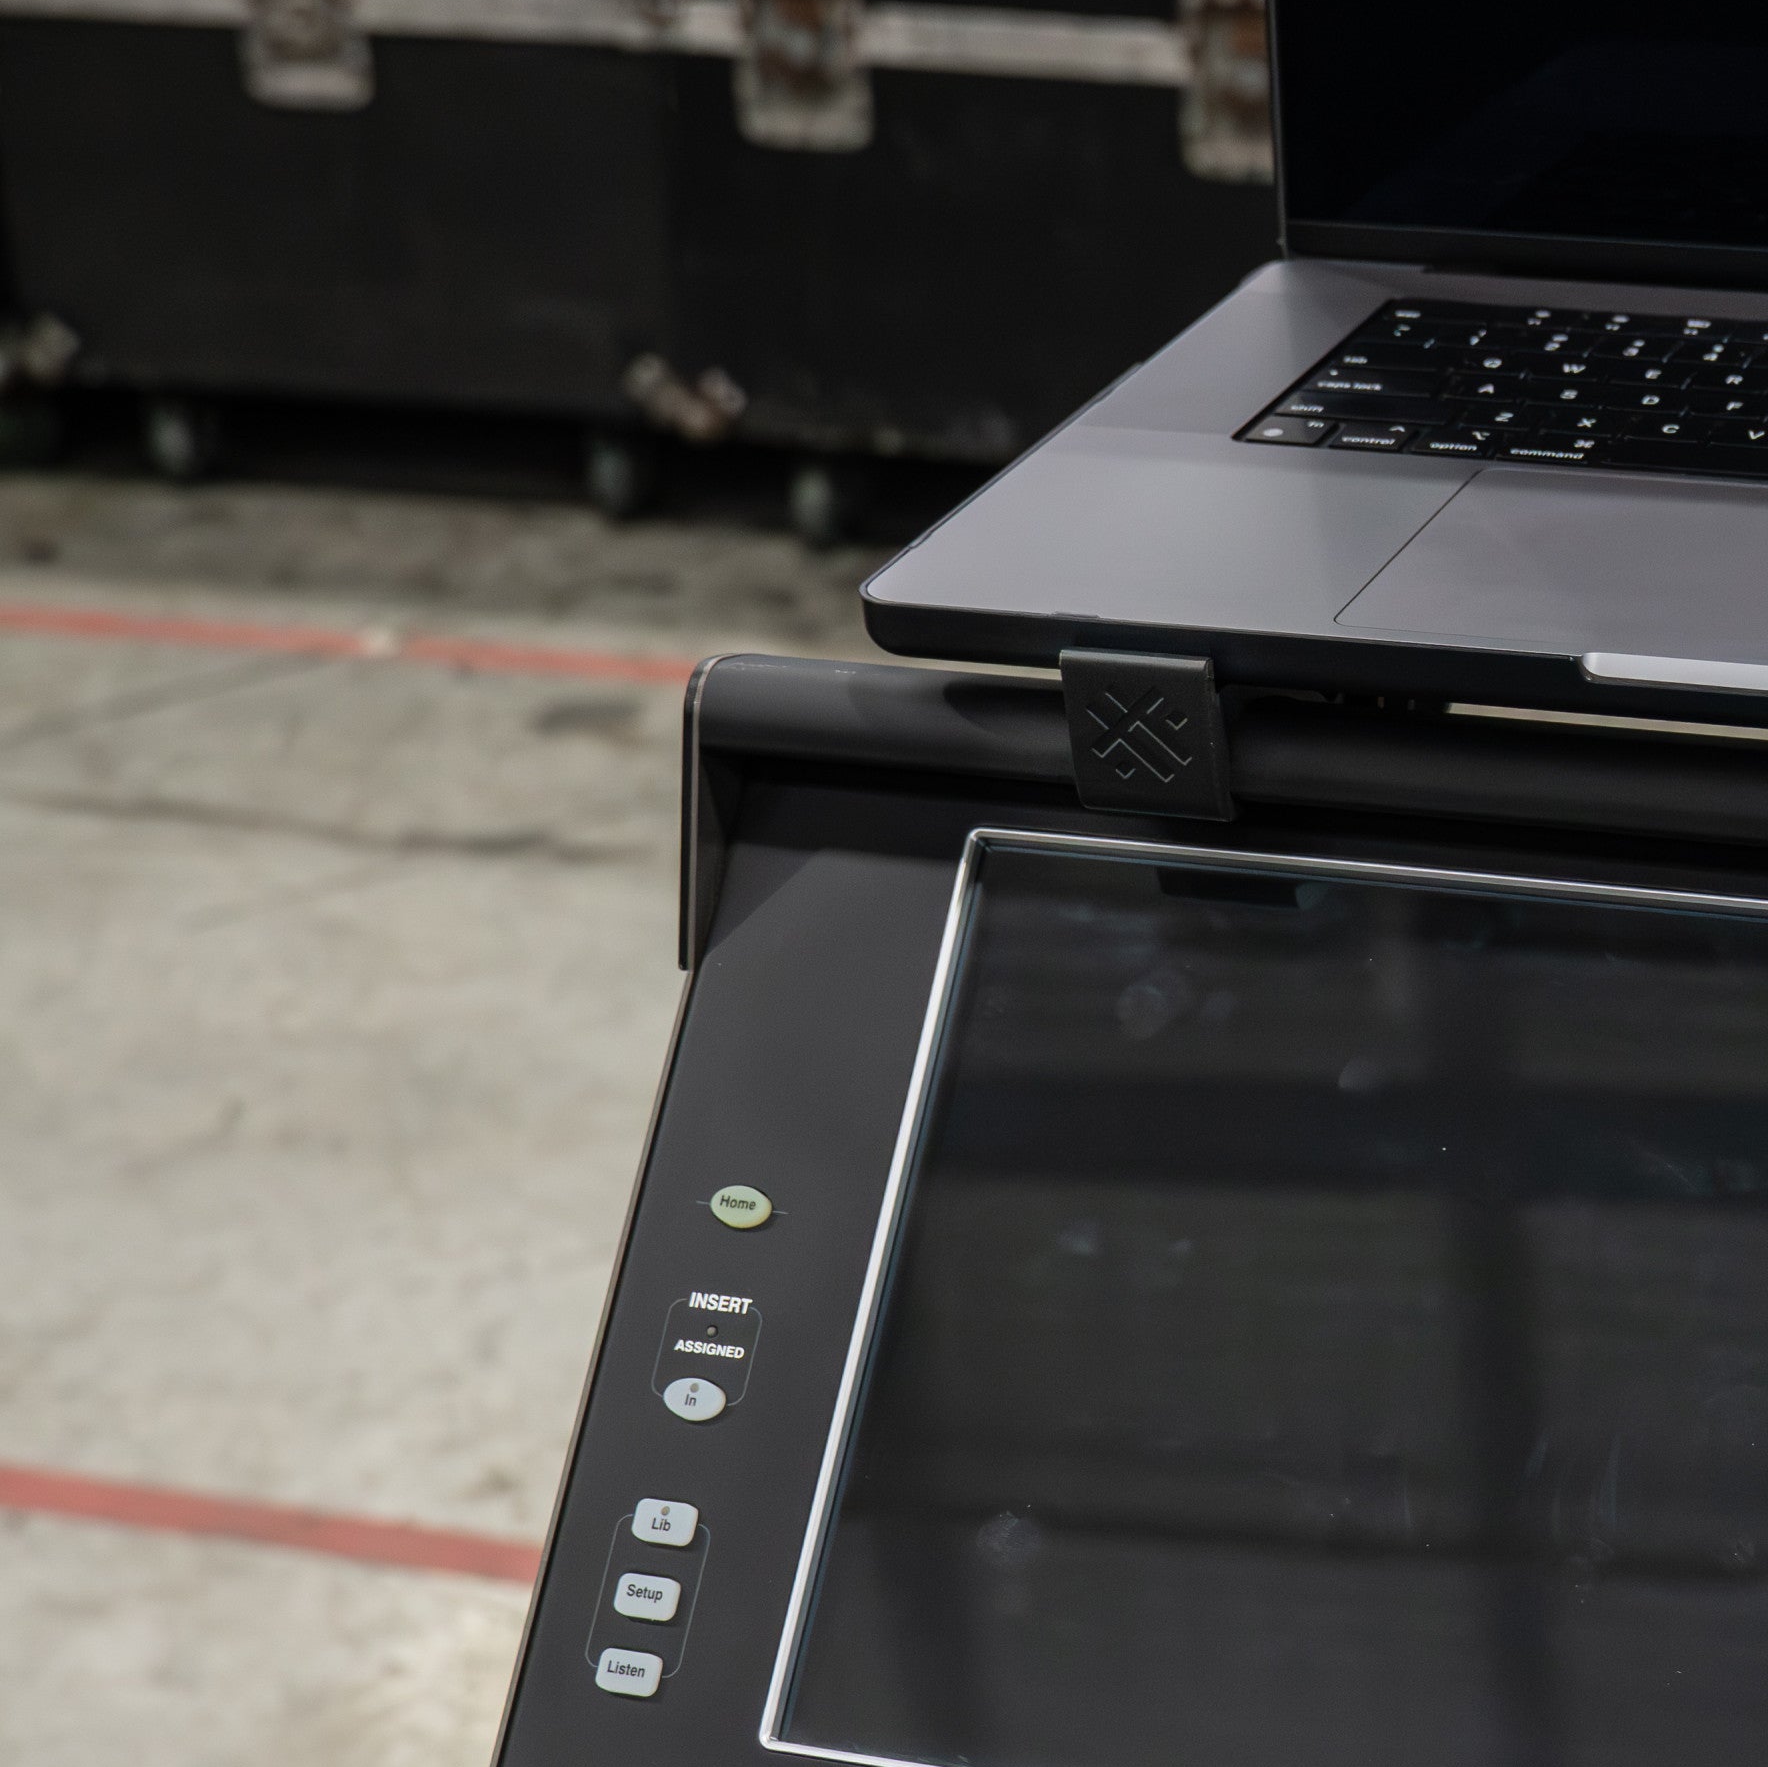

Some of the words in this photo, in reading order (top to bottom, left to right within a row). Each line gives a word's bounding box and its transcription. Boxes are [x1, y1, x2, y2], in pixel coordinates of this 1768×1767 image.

[1429, 440, 1478, 453] option
[1509, 447, 1585, 461] command
[720, 1195, 756, 1210] Home
[689, 1292, 752, 1314] INSERT
[674, 1340, 744, 1358] ASSIGNED
[685, 1394, 696, 1406] In
[652, 1518, 670, 1531] Lib
[627, 1584, 662, 1602] Setup
[608, 1661, 645, 1677] Listen
